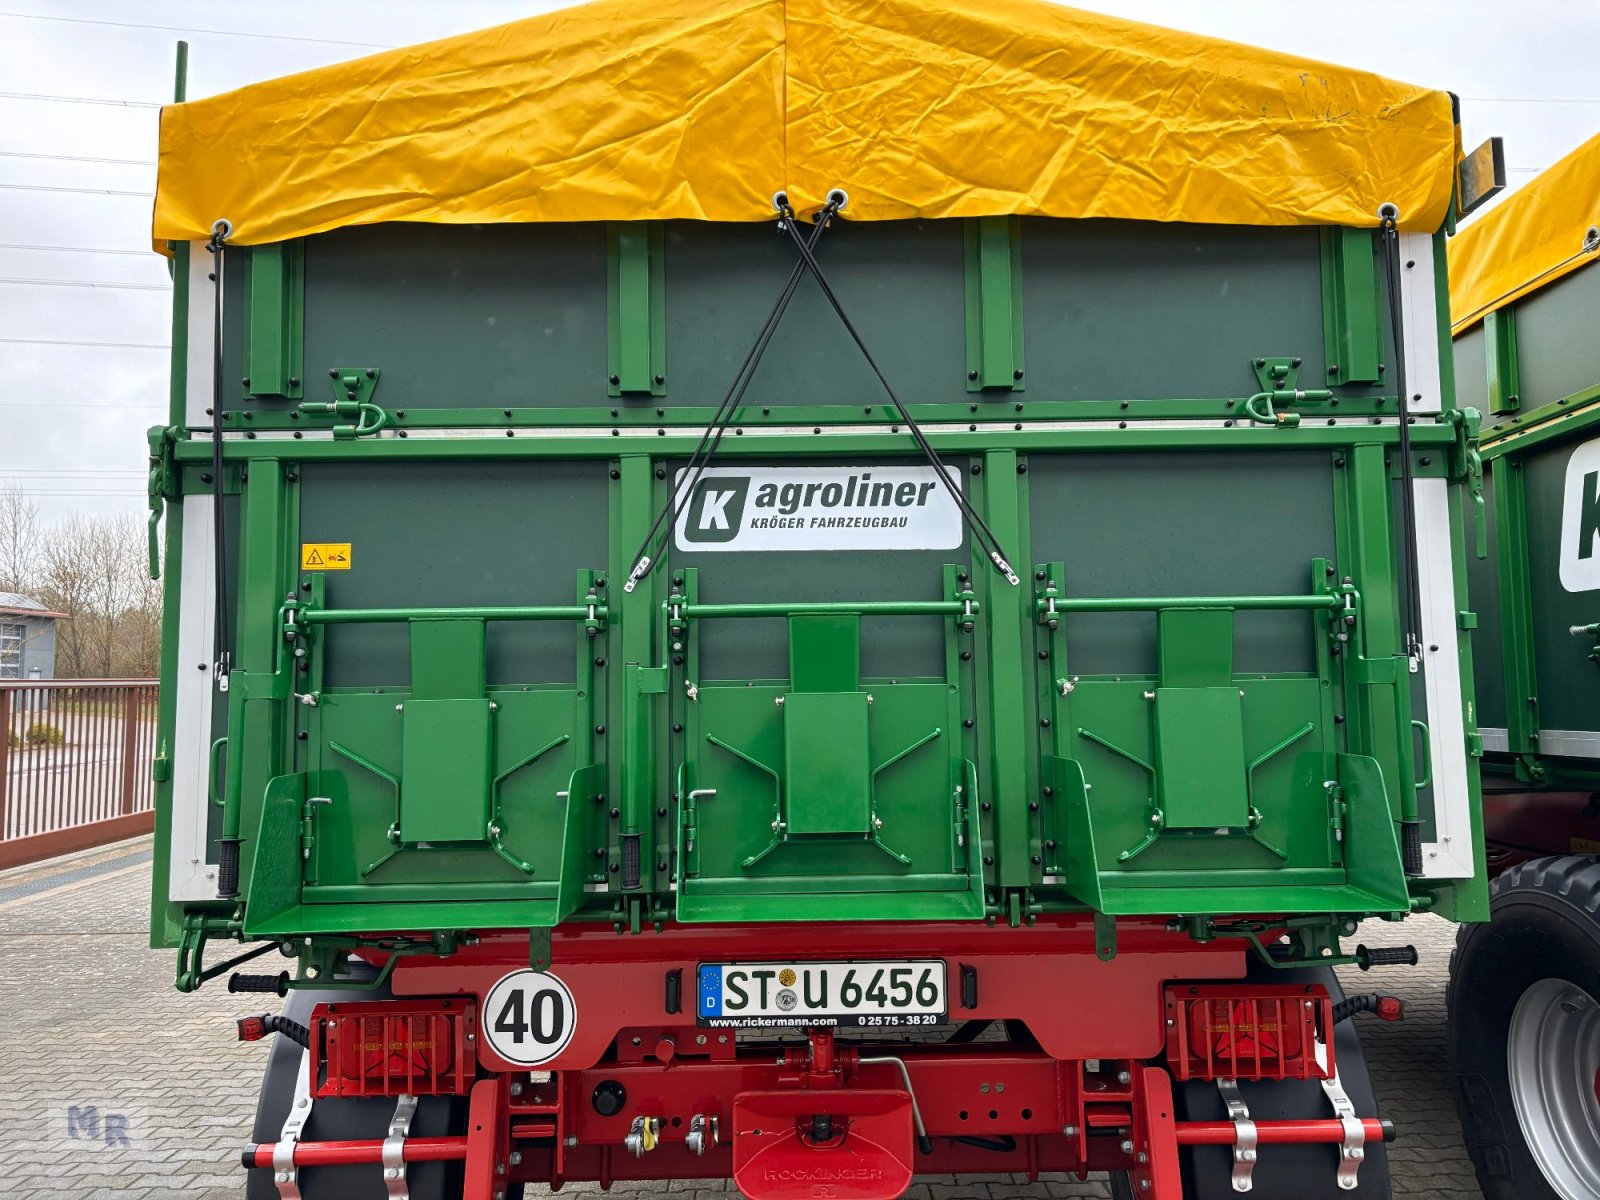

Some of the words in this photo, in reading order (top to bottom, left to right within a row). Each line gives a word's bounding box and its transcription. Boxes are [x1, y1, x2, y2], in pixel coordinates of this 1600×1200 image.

[698, 490, 737, 530] K
[755, 473, 936, 515] agroliner
[750, 517, 805, 529] KRÖGER
[809, 516, 908, 529] FAHRZEUGBAU
[706, 997, 716, 1008] D
[725, 970, 776, 1010] ST
[803, 970, 828, 1009] U
[840, 968, 938, 1008] 6456
[494, 988, 564, 1045] 40
[709, 1017, 838, 1027] www.rickermann.com
